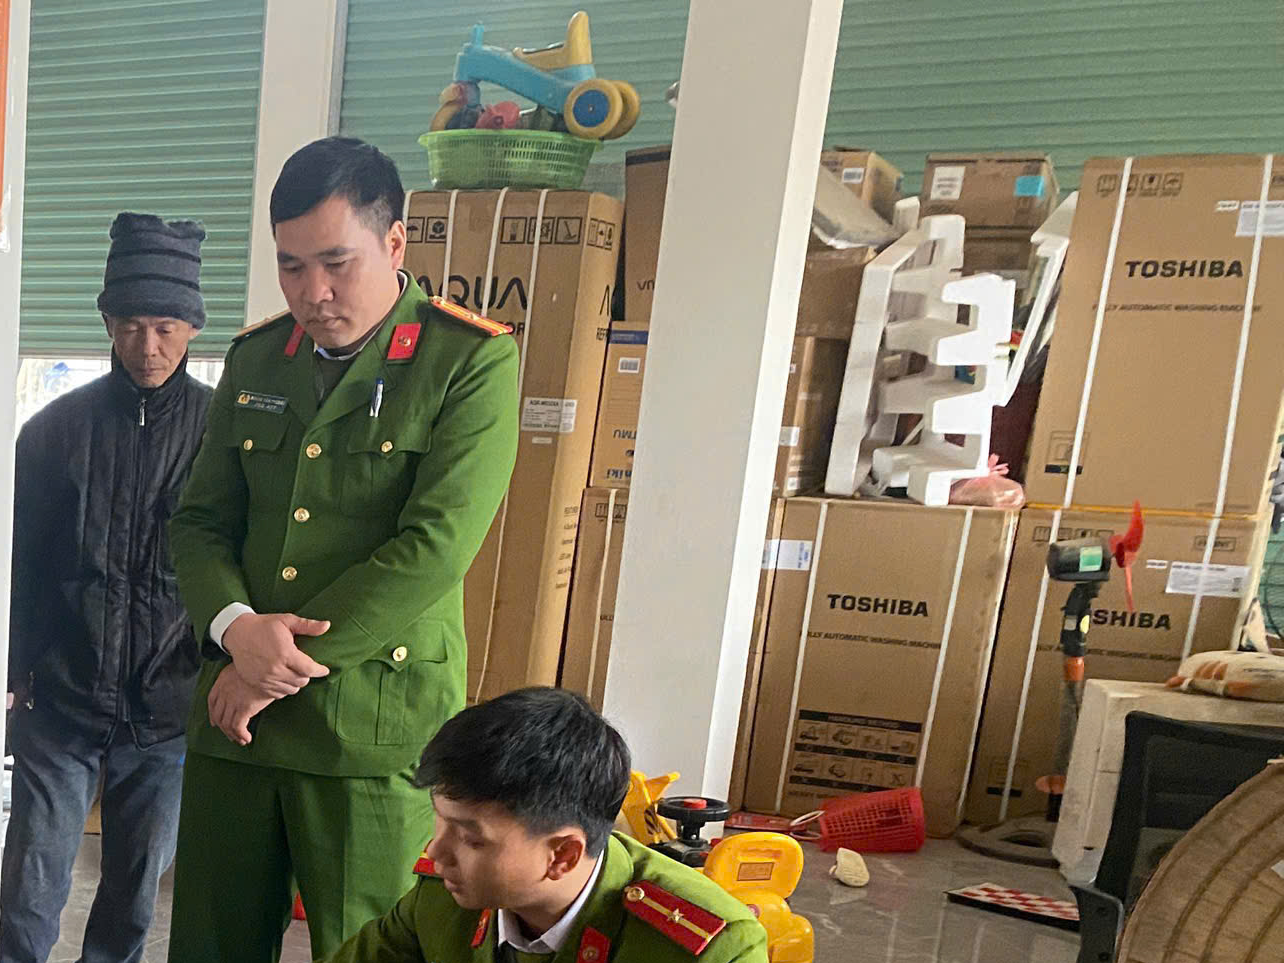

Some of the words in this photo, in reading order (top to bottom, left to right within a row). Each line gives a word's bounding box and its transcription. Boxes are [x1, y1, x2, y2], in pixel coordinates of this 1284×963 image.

[1124, 259, 1244, 279] TOSHIBA
[826, 593, 929, 617] TOSHIBA
[1090, 608, 1171, 631] SHIBA
